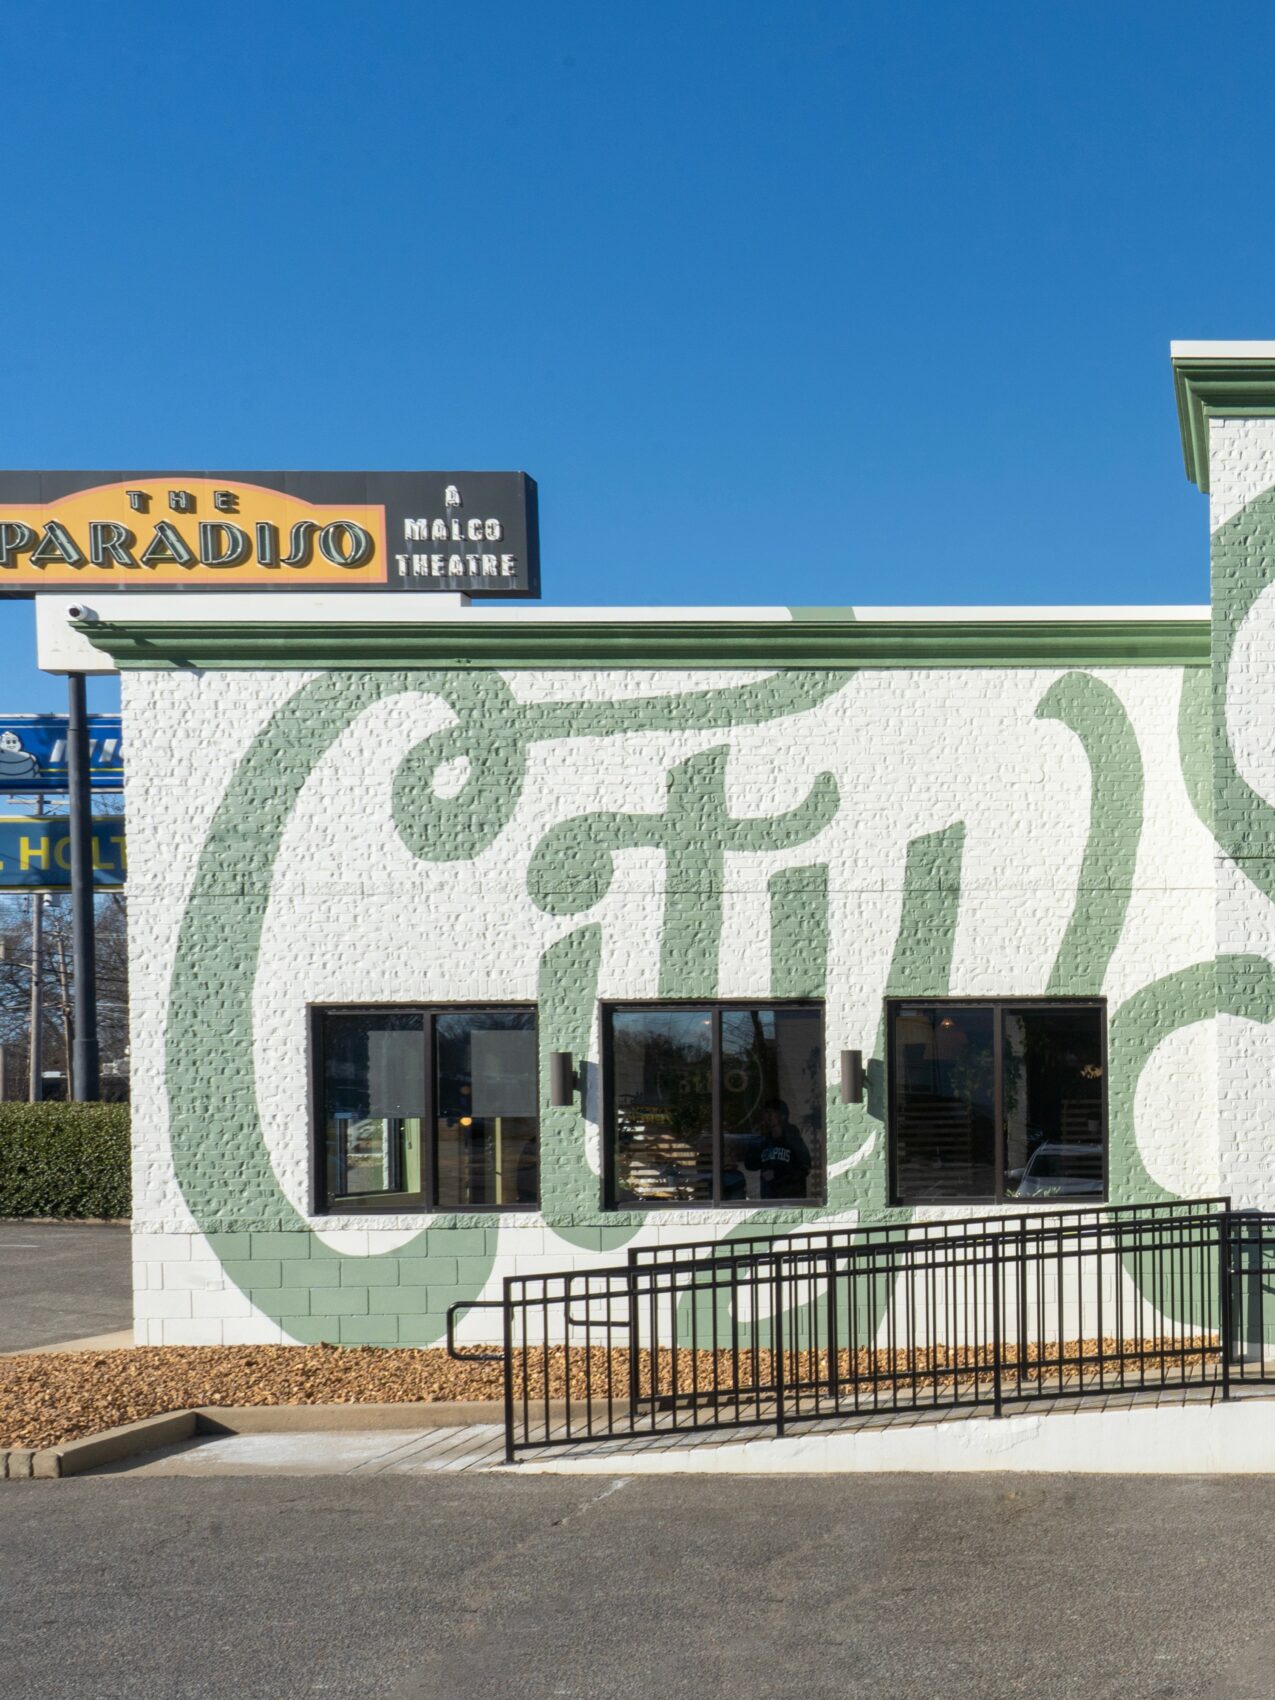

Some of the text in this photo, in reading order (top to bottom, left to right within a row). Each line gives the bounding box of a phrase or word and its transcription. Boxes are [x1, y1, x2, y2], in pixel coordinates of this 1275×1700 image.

[126, 490, 240, 514] THE
[445, 485, 462, 507] A
[404, 518, 502, 541] MALCO
[0, 519, 375, 569] PARADISO
[395, 554, 517, 577] THEATRE
[166, 640, 1143, 1347] City
